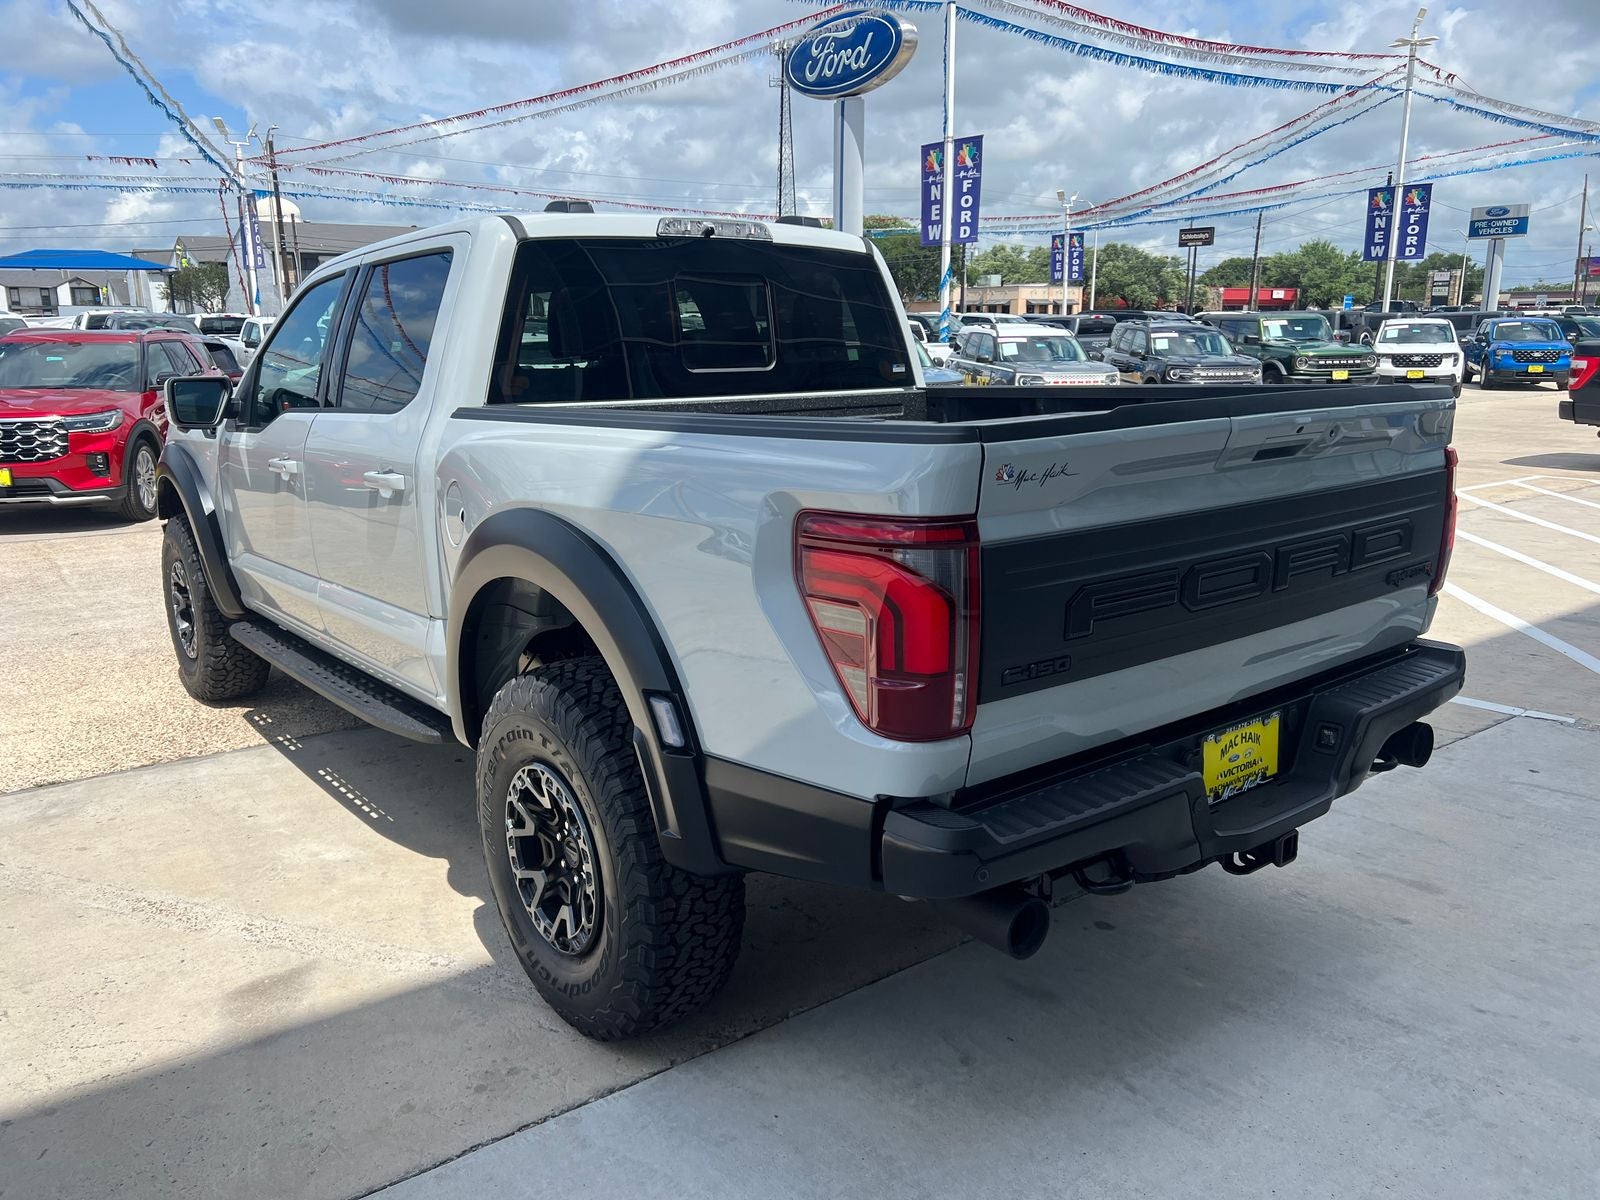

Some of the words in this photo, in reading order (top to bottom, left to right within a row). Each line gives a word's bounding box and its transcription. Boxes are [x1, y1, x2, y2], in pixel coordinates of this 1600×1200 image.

[805, 26, 873, 82] Ford
[928, 184, 942, 241] NEW
[960, 179, 973, 239] FORD
[254, 223, 263, 266] FORD
[1370, 216, 1386, 258] NEW
[1404, 214, 1420, 257] FORD
[1478, 226, 1513, 236] VEHICLES
[1054, 253, 1063, 280] NEW
[1071, 251, 1080, 279] FORD
[1064, 518, 1414, 641] FORD
[1001, 655, 1071, 687] F-150
[1220, 735, 1239, 760] MAC
[1240, 731, 1261, 746] HAIK
